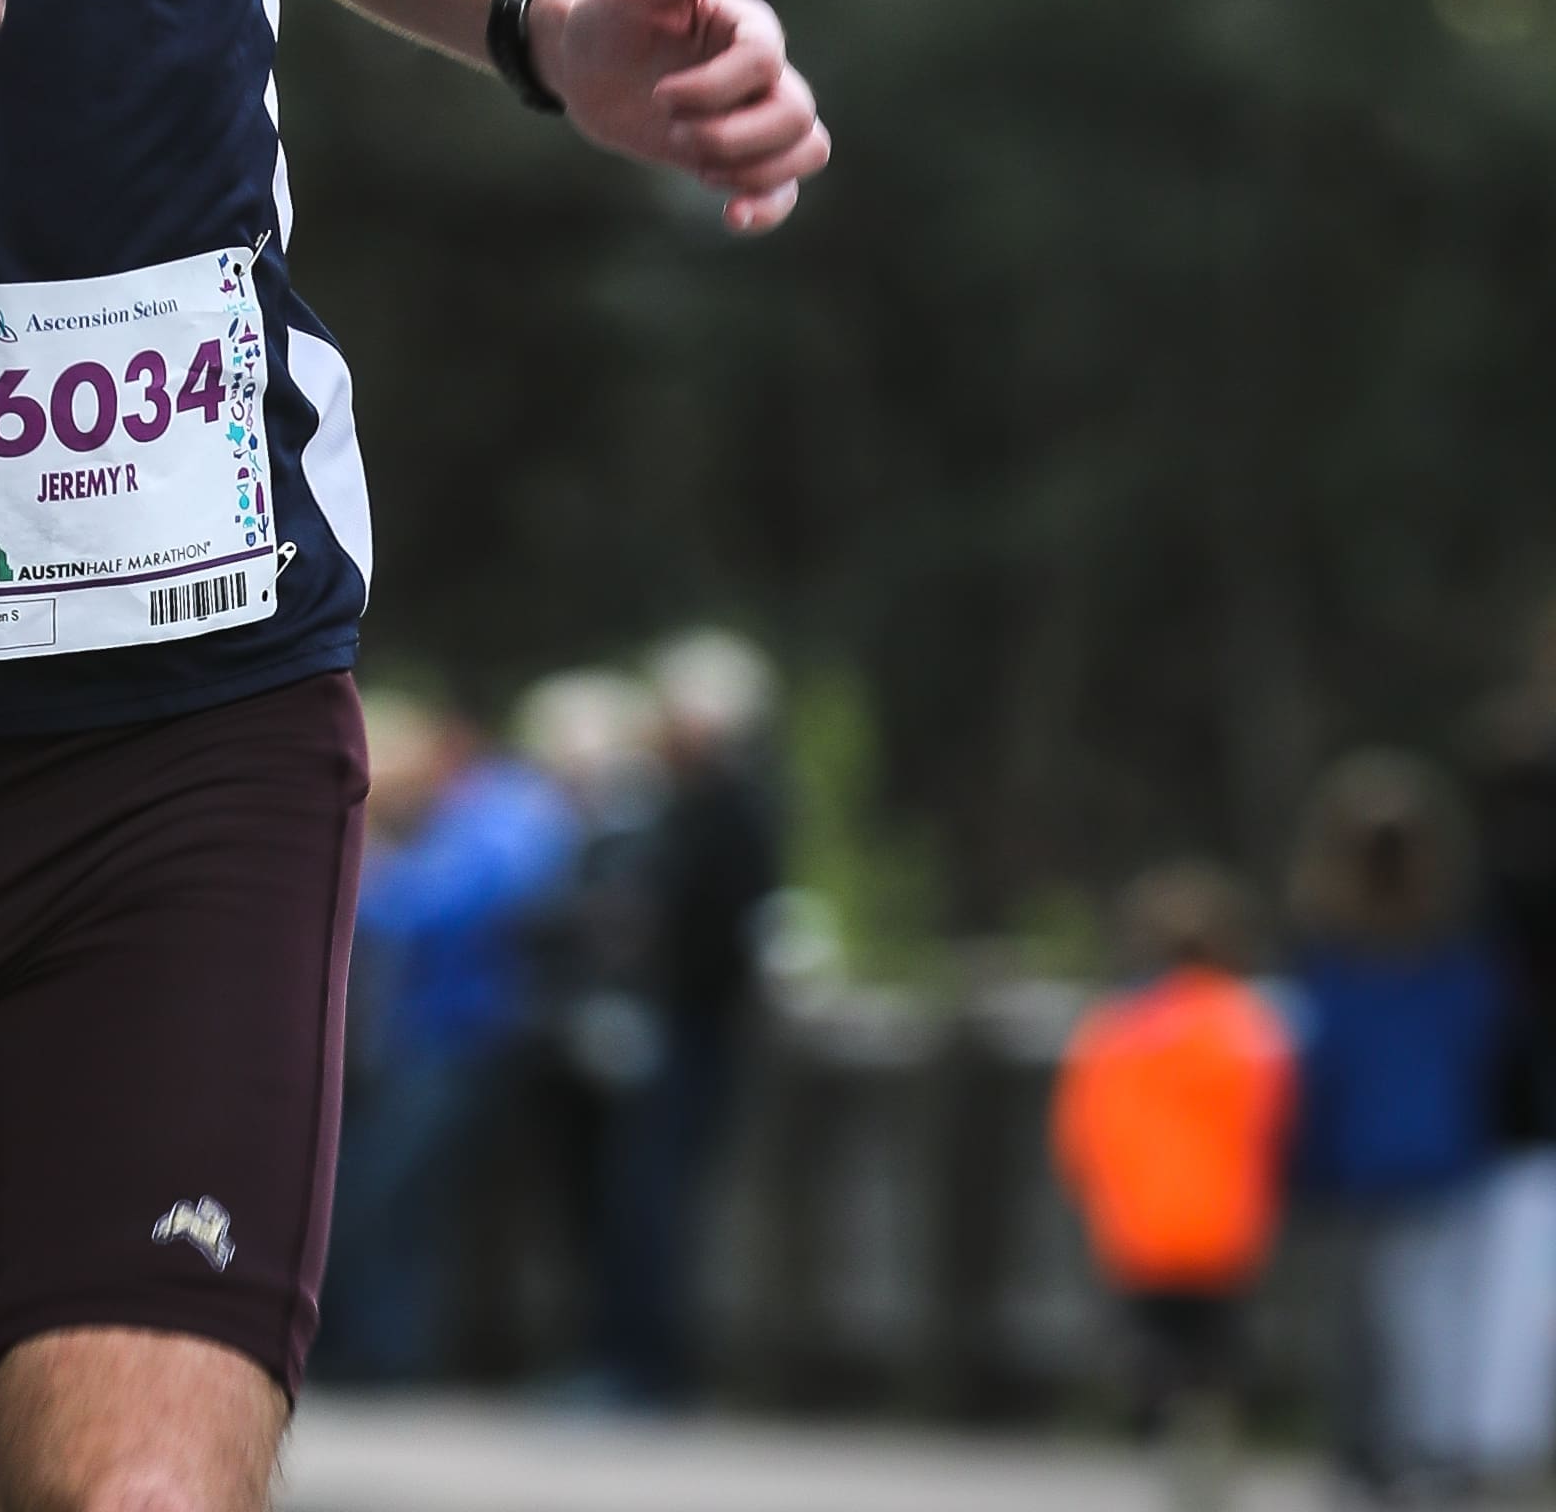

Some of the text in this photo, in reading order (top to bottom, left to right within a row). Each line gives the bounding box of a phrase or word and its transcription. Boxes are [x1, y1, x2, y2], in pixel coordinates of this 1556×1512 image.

[25, 298, 179, 333] Ascension Seton
[37, 463, 139, 502] JEREMY R
[11, 609, 20, 622] S
